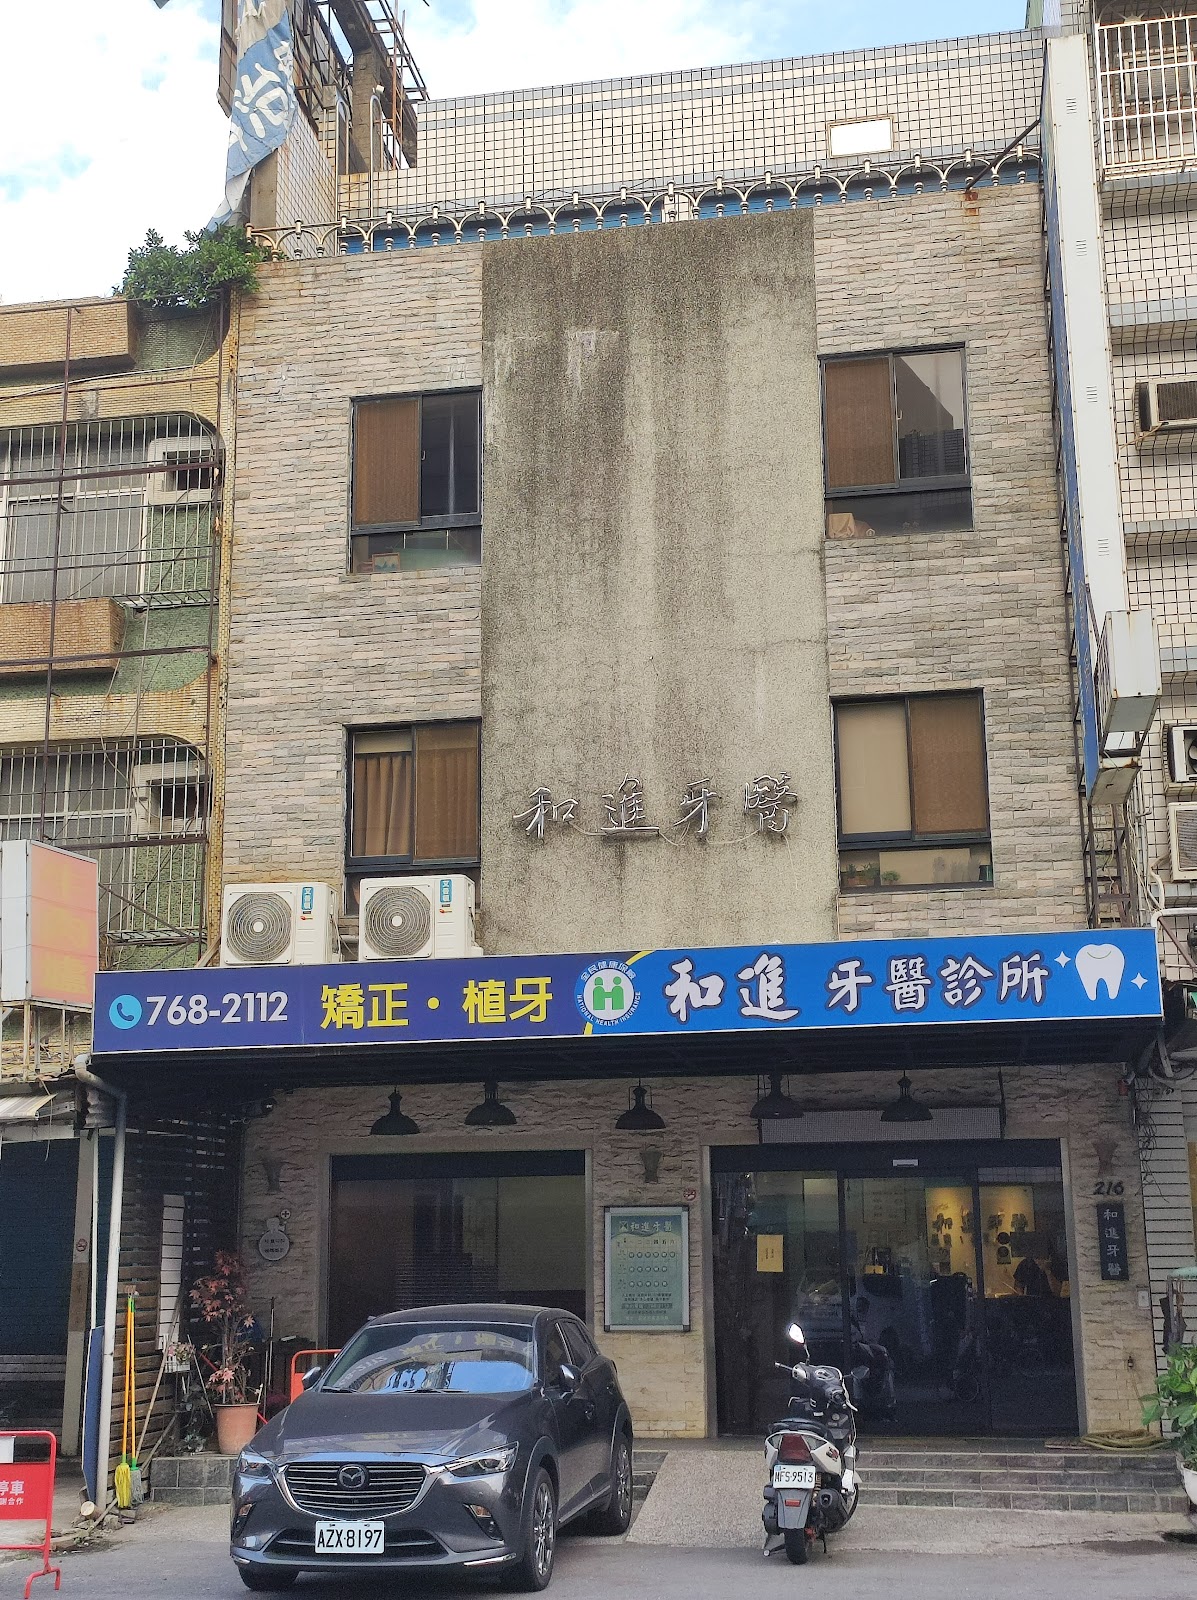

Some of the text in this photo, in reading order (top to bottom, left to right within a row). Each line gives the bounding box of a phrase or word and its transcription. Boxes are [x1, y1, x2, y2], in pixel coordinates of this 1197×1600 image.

[146, 992, 288, 1026] 768-2112
[577, 991, 641, 1027] NATIONAL HEALTH INSURANCE
[1093, 1181, 1124, 1195] 216
[1103, 1208, 1121, 1276] 和進牙醫
